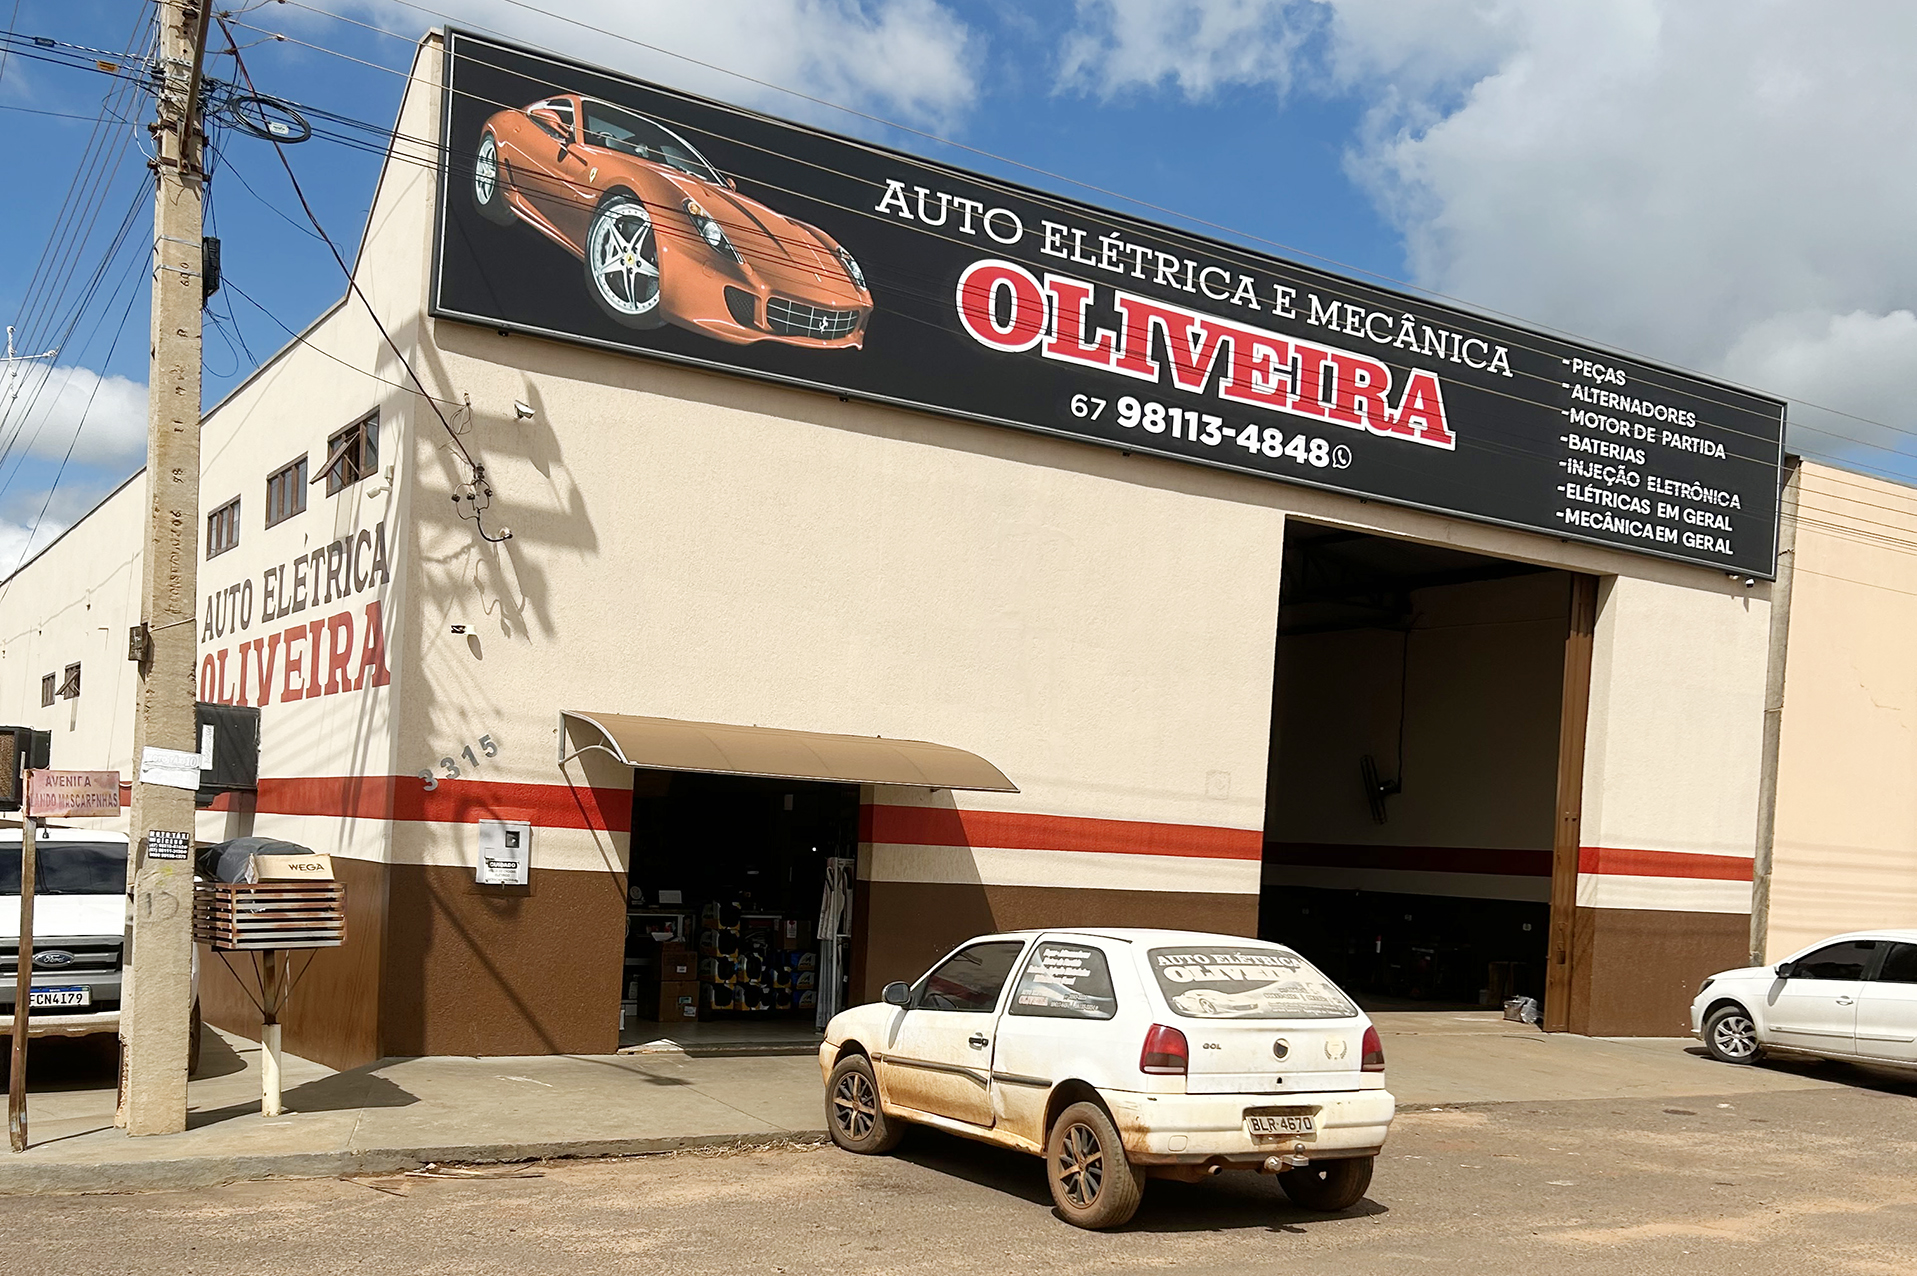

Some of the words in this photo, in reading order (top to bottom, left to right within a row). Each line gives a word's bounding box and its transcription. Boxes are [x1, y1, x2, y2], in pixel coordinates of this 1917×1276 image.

[875, 179, 1024, 245] AUTO
[1040, 219, 1262, 310] ELÉTRICA
[1272, 284, 1297, 318] E
[1306, 295, 1514, 378] MECÂNICA
[956, 258, 1457, 451] OLIVEIRA
[1562, 382, 1697, 428] -ALTERNADORES
[1070, 394, 1107, 422] 67
[1116, 396, 1330, 469] 98113-4848
[1560, 433, 1646, 465] -BATERIAS
[1634, 423, 1656, 443] DE
[1662, 430, 1727, 460] PARTIDA
[1647, 475, 1742, 510] ELETRÔNICA
[1657, 502, 1680, 521] EM
[1683, 508, 1733, 532] GERAL
[1682, 531, 1734, 555] GERAL
[201, 578, 253, 644] AUTO
[261, 521, 390, 624] ELÉTRICA
[200, 599, 391, 708] OLIVEIRA
[418, 734, 498, 791] 3315
[288, 863, 325, 872] WEGA
[1157, 953, 1210, 966] AUTO
[1210, 952, 1301, 968] ELÉTRICA
[1163, 965, 1308, 983] OLIV
